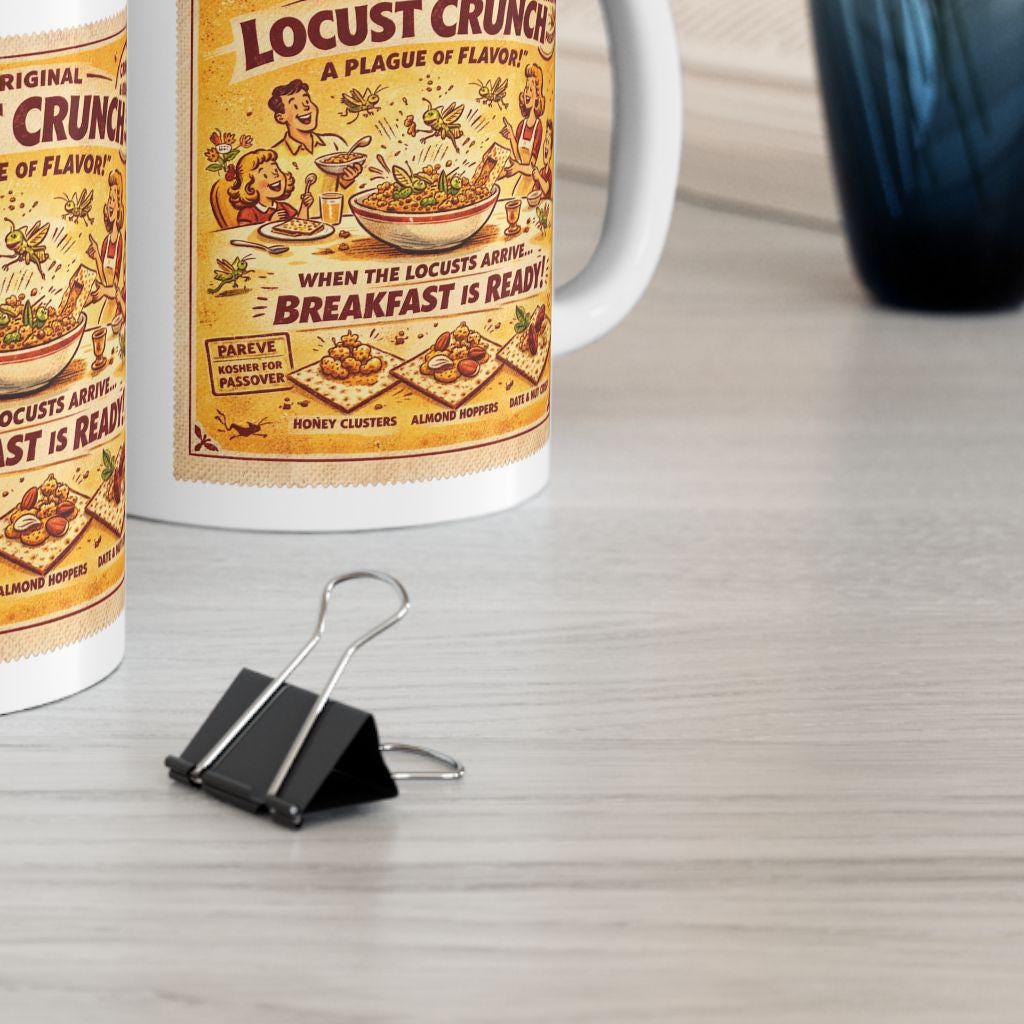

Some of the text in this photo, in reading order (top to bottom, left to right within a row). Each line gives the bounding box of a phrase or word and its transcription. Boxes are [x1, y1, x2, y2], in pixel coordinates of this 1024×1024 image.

[240, 0, 422, 71] LOCUST
[320, 62, 338, 81] A
[345, 50, 426, 77] PLAGUE
[432, 49, 453, 65] OF
[12, 96, 125, 146] CRUNCH
[15, 160, 38, 179] OF
[298, 244, 533, 287] WHEN THE LOCUSTS ARRIVE...
[273, 256, 545, 325] BREAKFAST IS READY!
[217, 341, 277, 357] PAREVE
[218, 360, 282, 375] KOSHER FOR
[219, 372, 286, 389] PASSOVER
[69, 377, 117, 410] ARRIVE...
[293, 416, 397, 430] HONEY CLUSTERS
[411, 402, 498, 425] ALMOND HOPPERS
[48, 427, 68, 456] IS
[47, 562, 88, 588] HOPPERS
